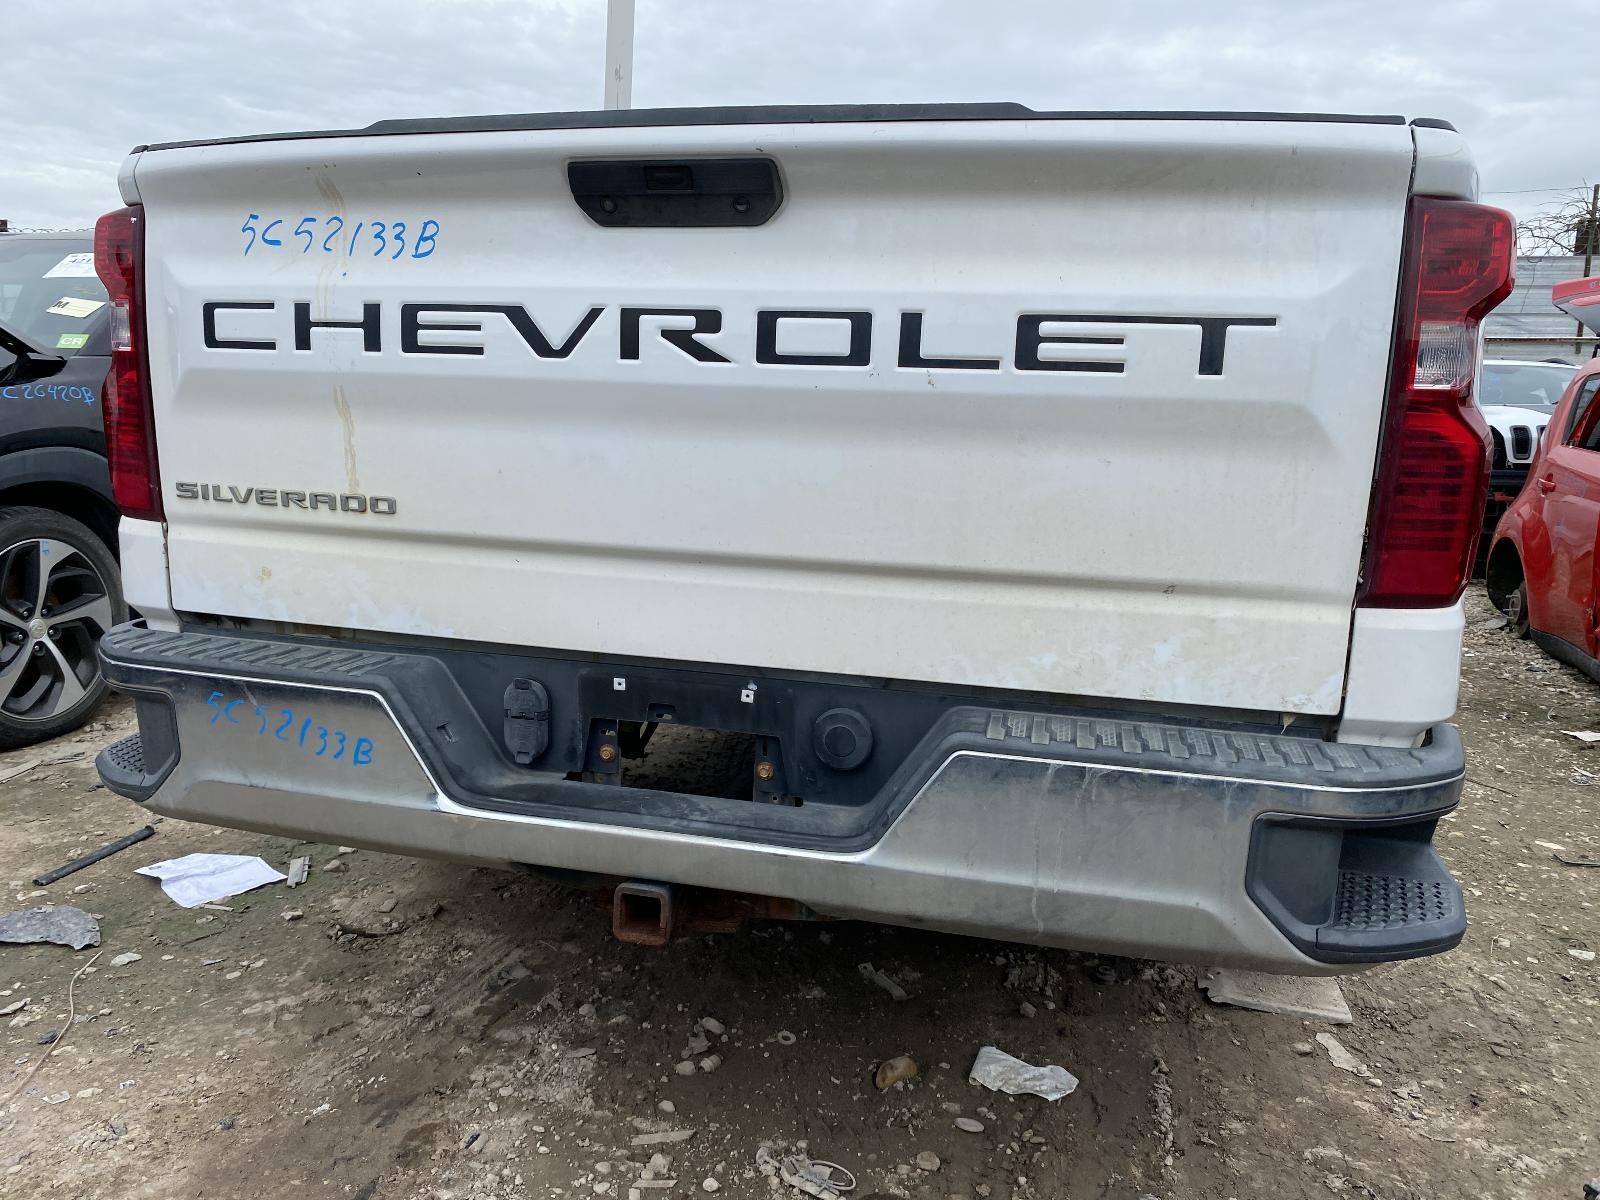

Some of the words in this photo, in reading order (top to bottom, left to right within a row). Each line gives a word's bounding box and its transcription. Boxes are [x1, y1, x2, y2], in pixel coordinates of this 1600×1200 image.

[61, 337, 83, 346] CR
[203, 301, 1276, 375] CHEVROLET
[0, 384, 95, 406] C26420B
[175, 481, 397, 515] SILVERADO
